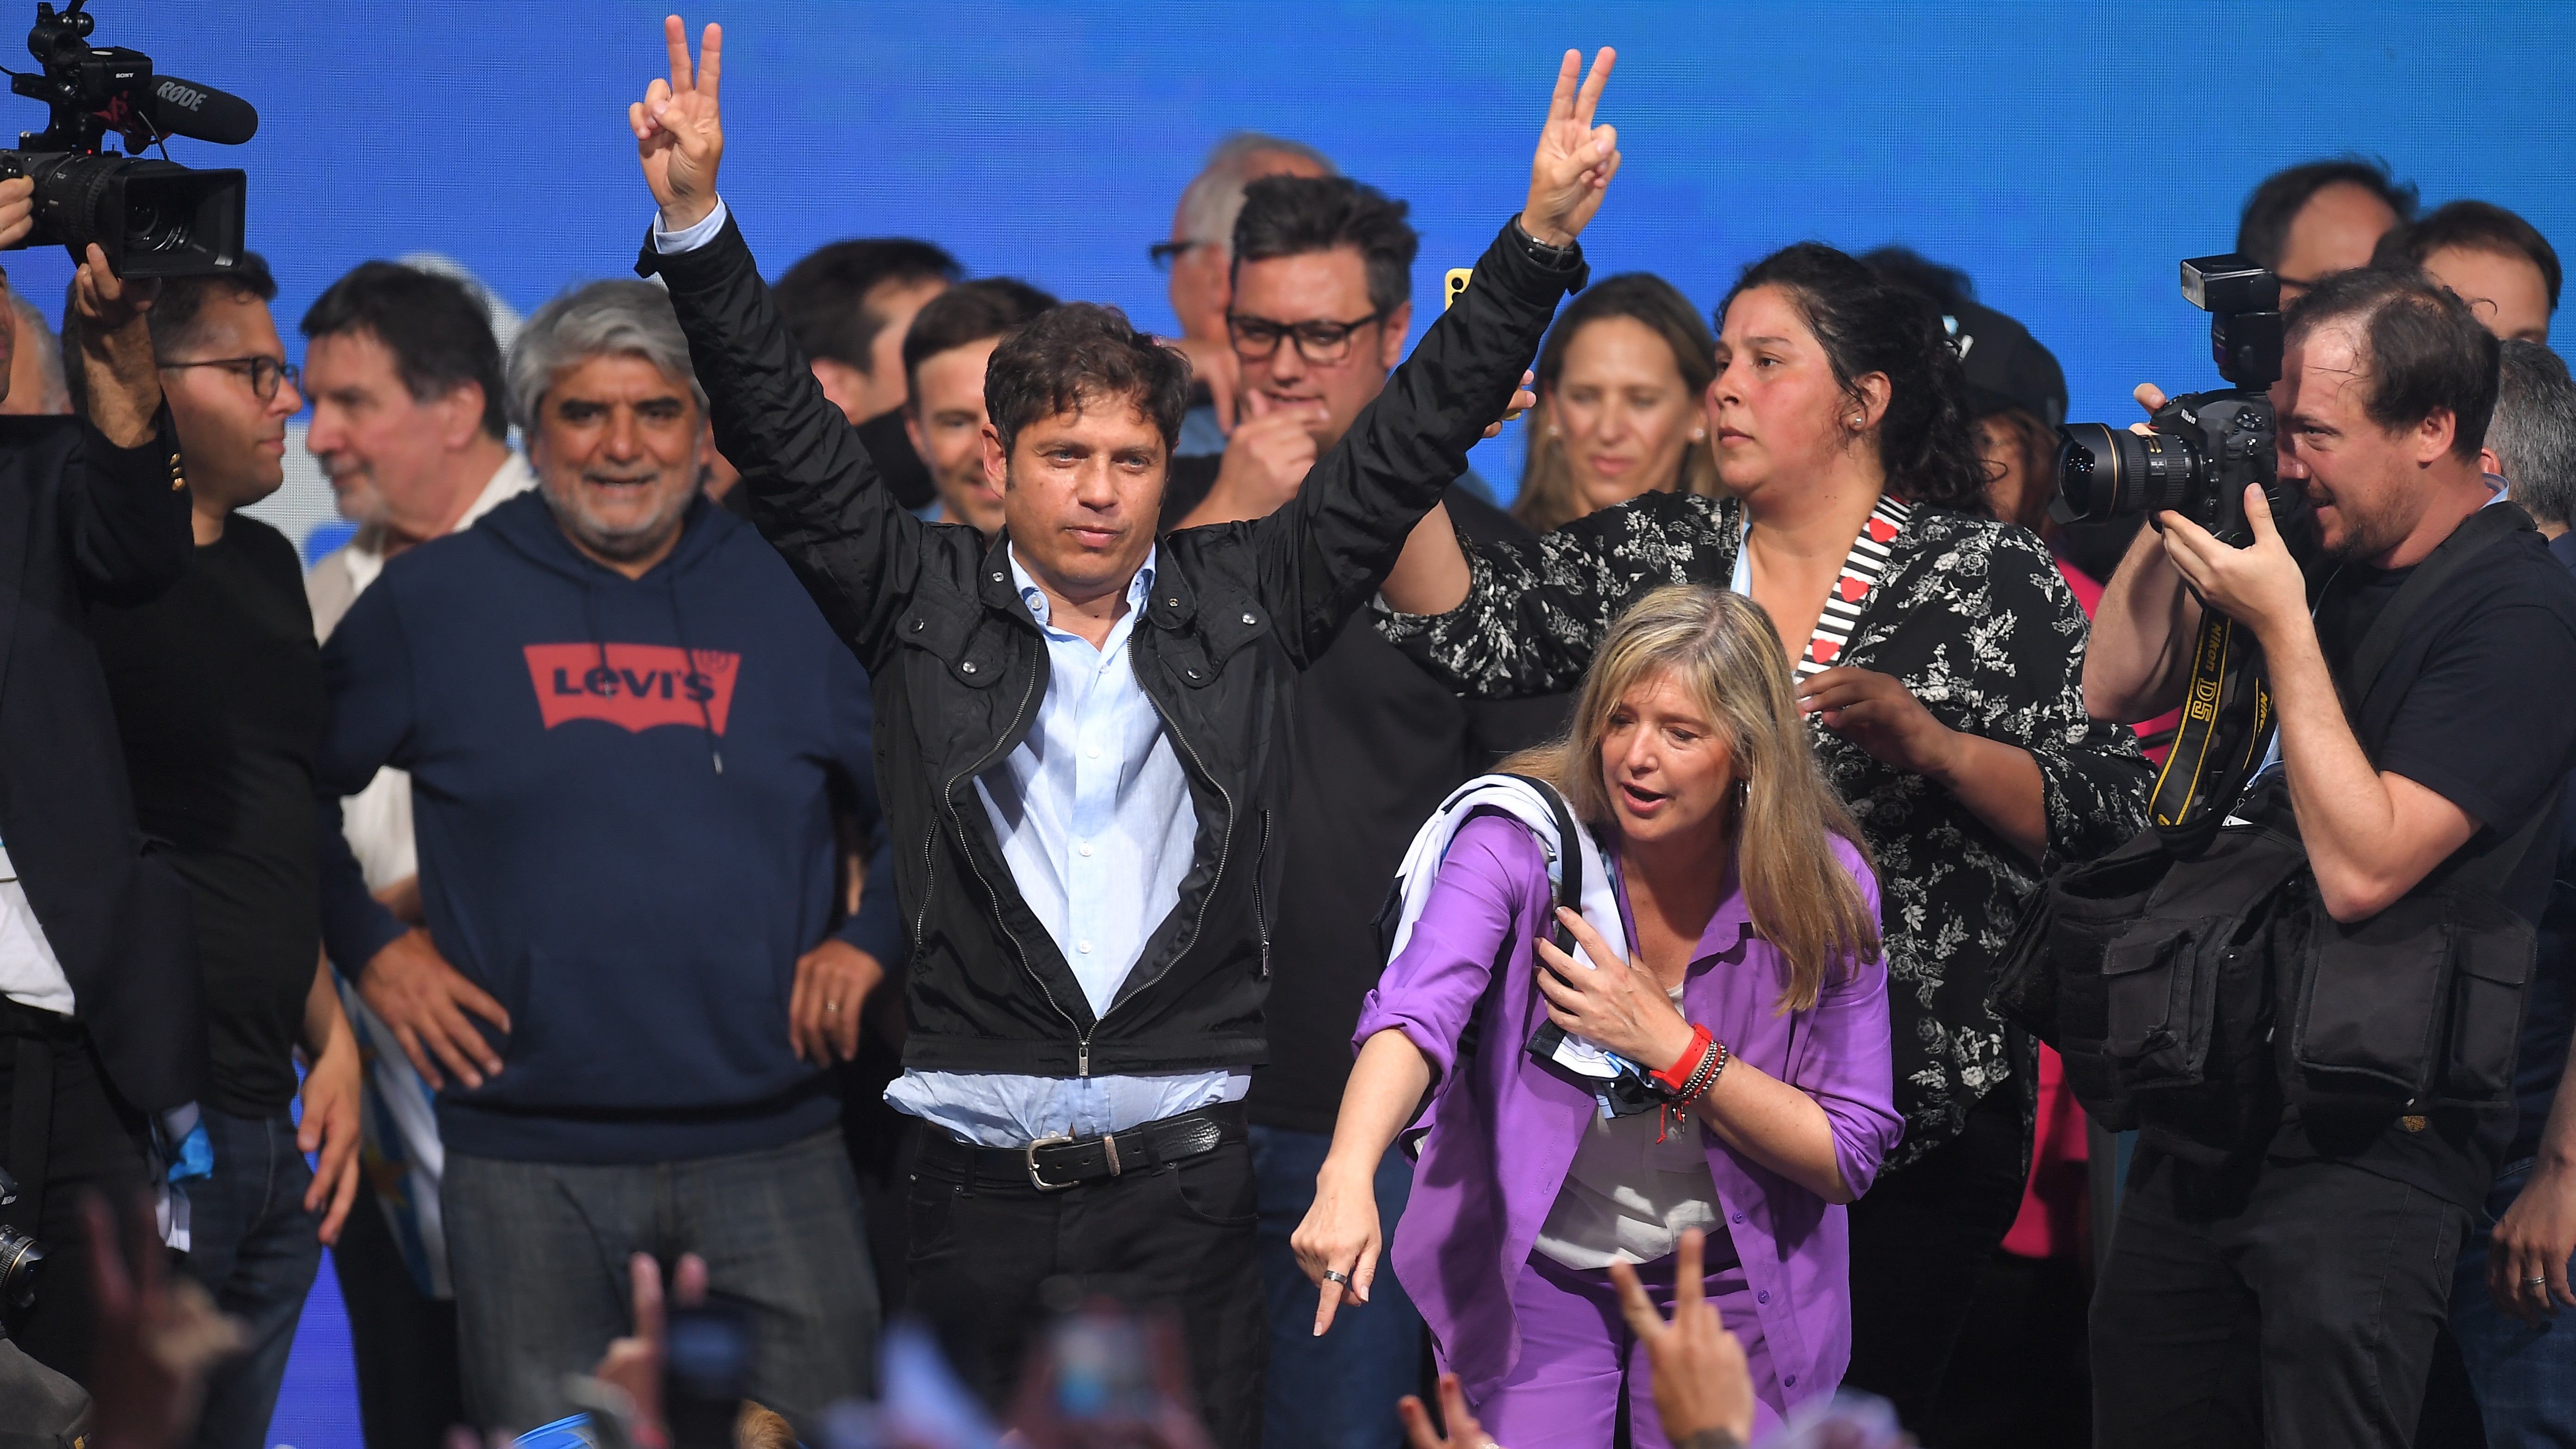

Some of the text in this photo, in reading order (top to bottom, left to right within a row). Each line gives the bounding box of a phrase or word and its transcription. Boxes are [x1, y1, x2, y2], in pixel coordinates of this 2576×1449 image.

[157, 81, 208, 112] RØDE
[2181, 408, 2196, 425] Nikon
[2191, 622, 2221, 722] Nikon D5
[2258, 691, 2268, 737] Niko
